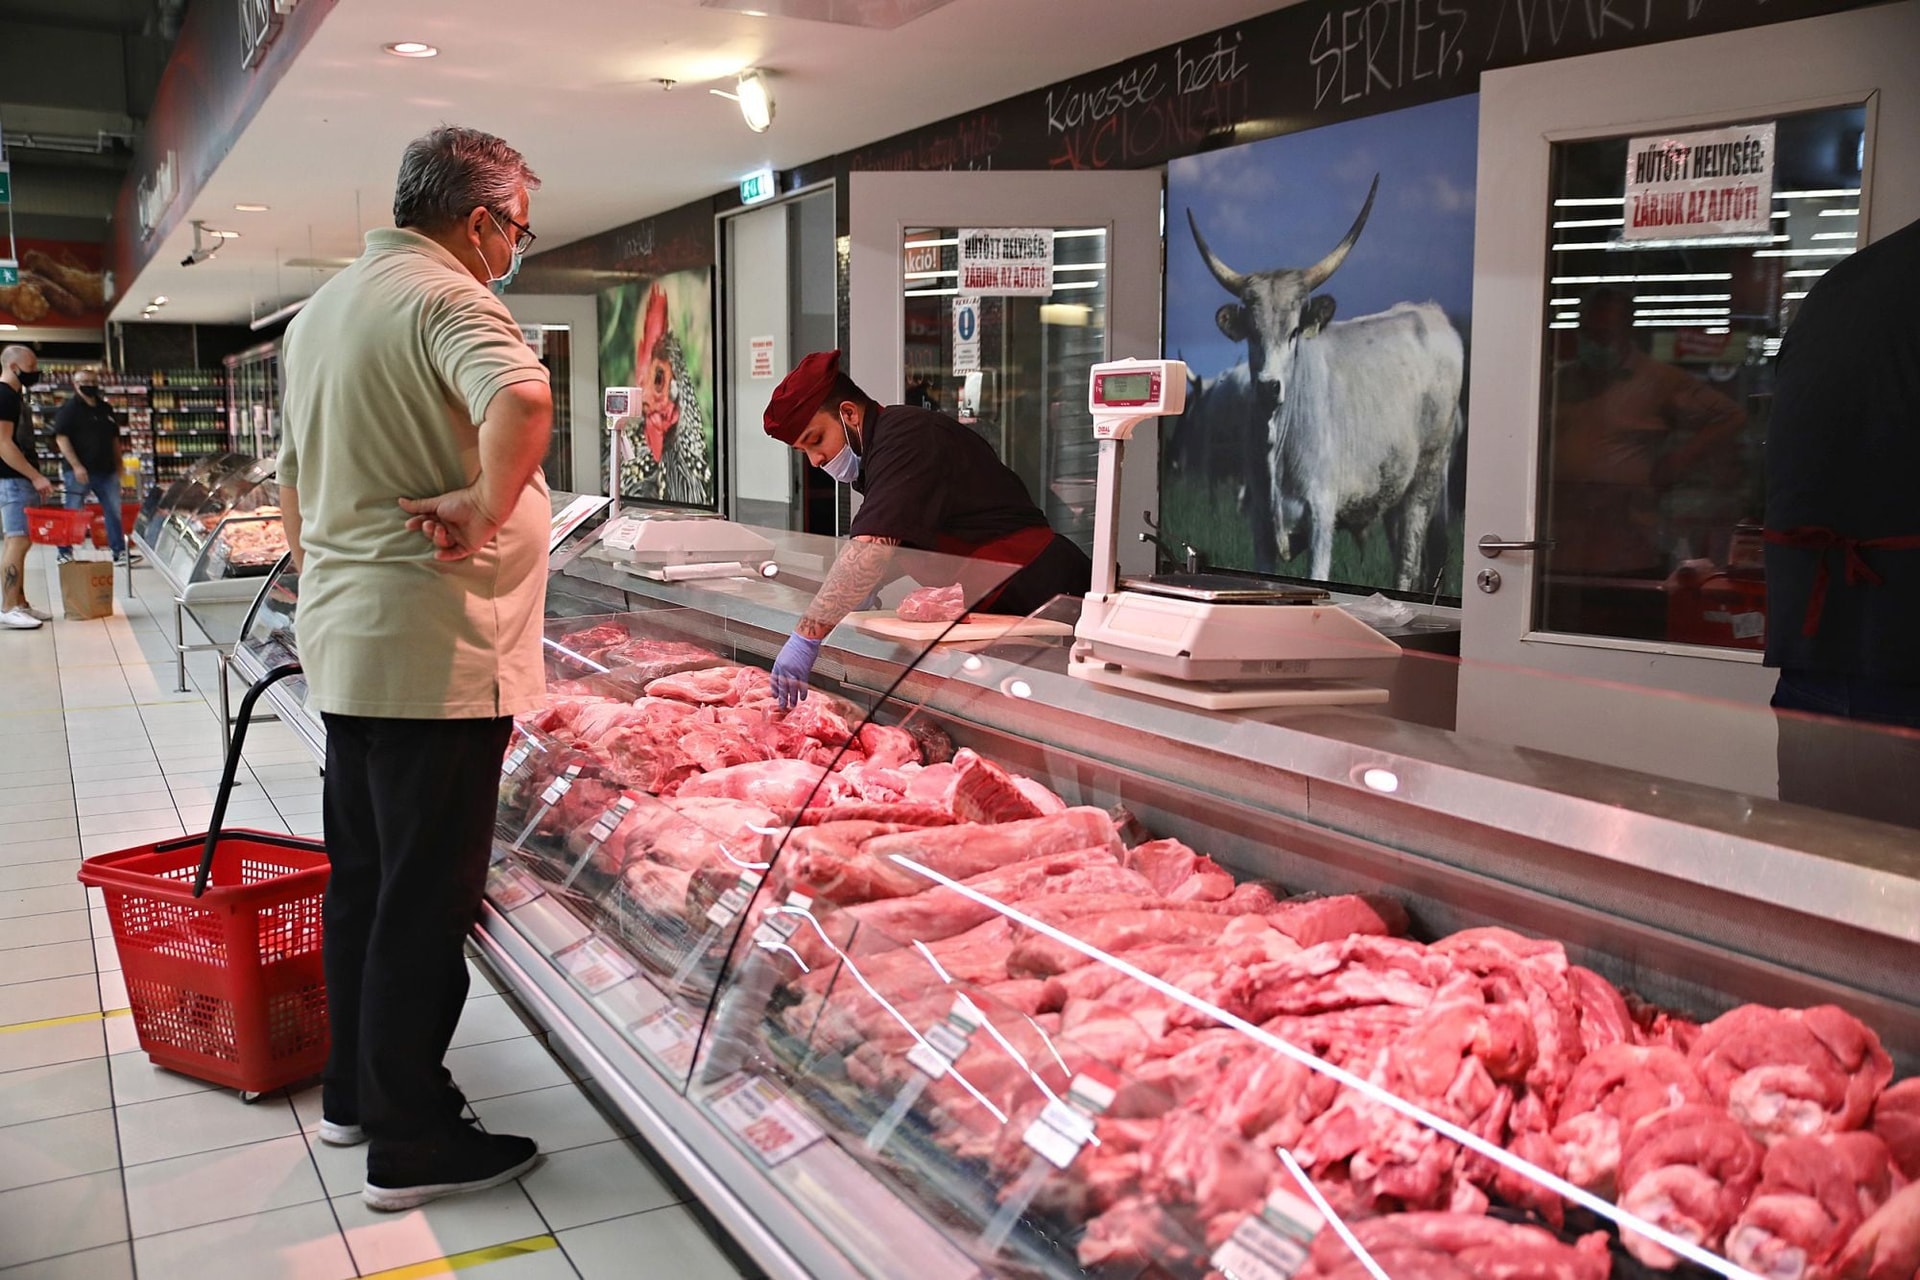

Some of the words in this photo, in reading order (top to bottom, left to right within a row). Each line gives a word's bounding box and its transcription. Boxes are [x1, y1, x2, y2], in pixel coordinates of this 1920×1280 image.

[1046, 63, 1166, 135] Keresse
[1175, 31, 1249, 96] heti
[1635, 144, 1691, 184] HŰTÖTT
[1693, 135, 1765, 179] HELYISÉG:
[1633, 189, 1685, 227] ZÁRJUK
[1687, 189, 1705, 223] AZ
[1707, 182, 1759, 222] AJTÓT!
[1002, 234, 1047, 259] HELYISÉG:
[964, 263, 999, 288] ZÁRJUK
[1001, 266, 1012, 288] AZ
